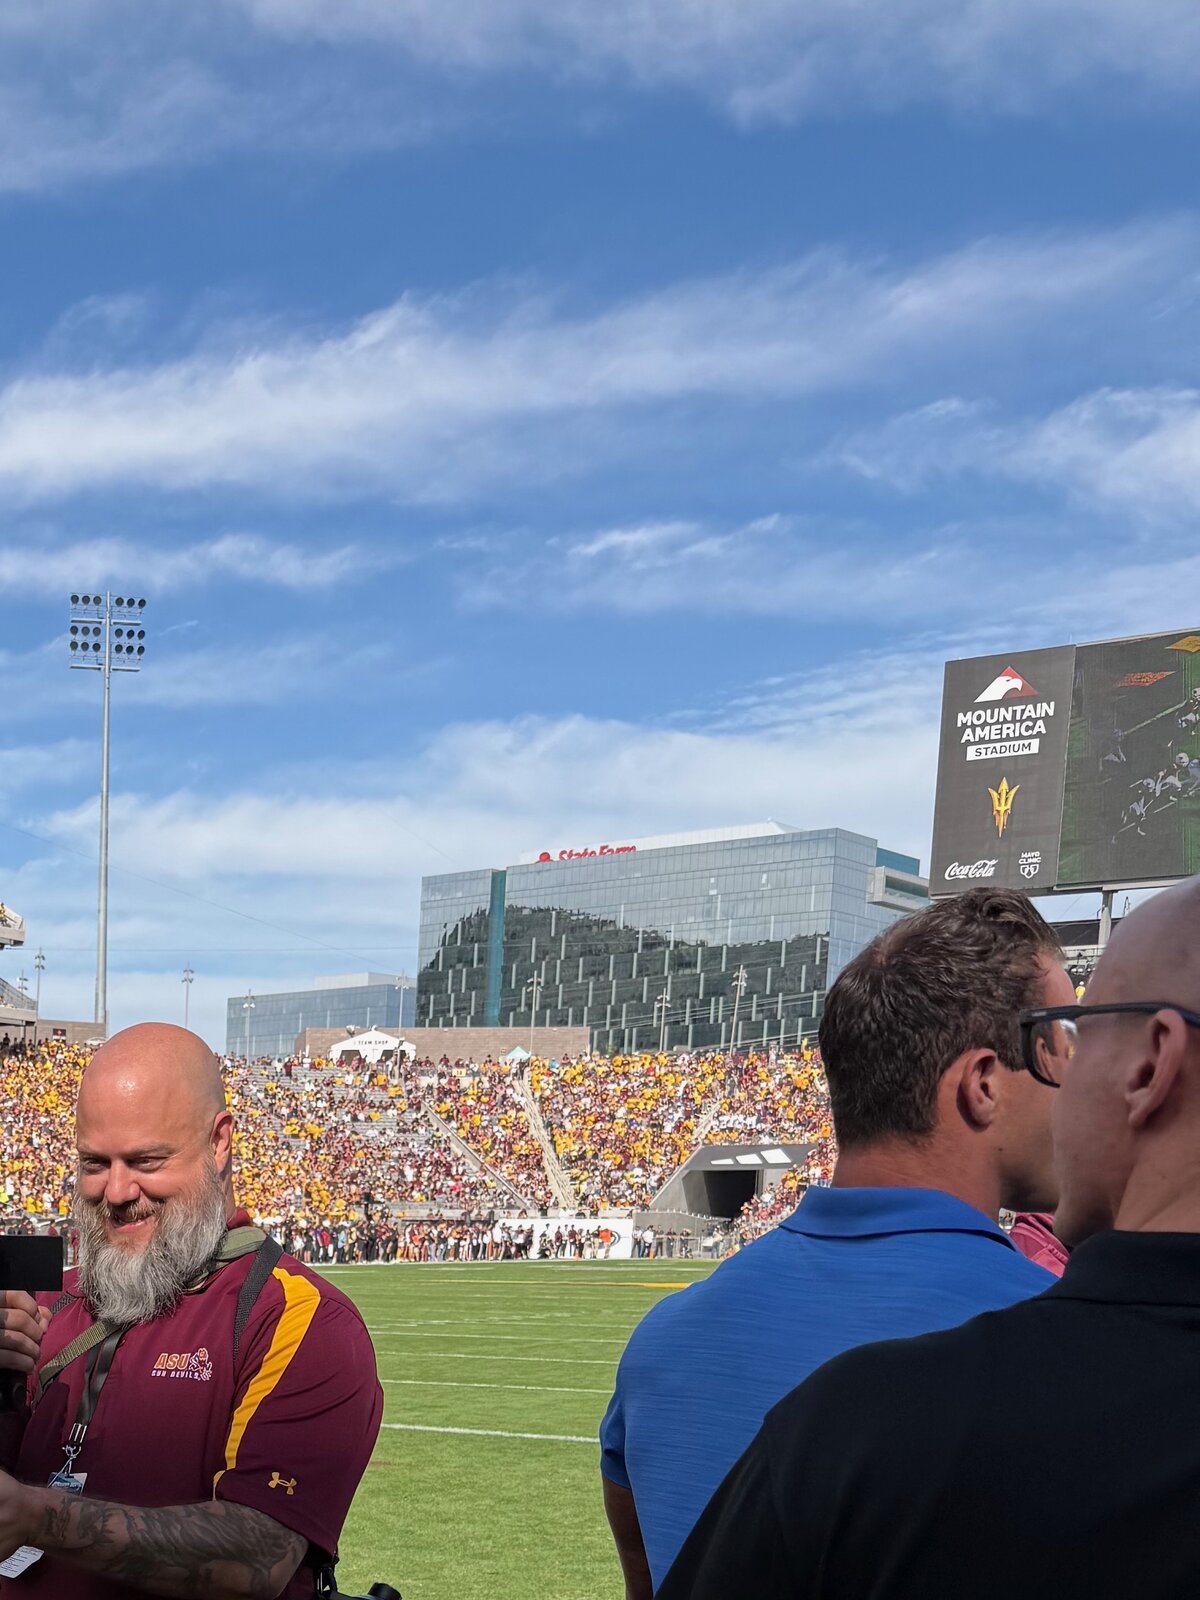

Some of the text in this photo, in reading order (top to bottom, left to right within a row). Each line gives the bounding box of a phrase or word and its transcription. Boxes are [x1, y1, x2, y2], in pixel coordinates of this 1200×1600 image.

[956, 701, 1055, 728] MOUNTAIN
[960, 719, 1047, 744] AMERICA
[974, 742, 1032, 757] STADIUM
[154, 1353, 191, 1370] ASU
